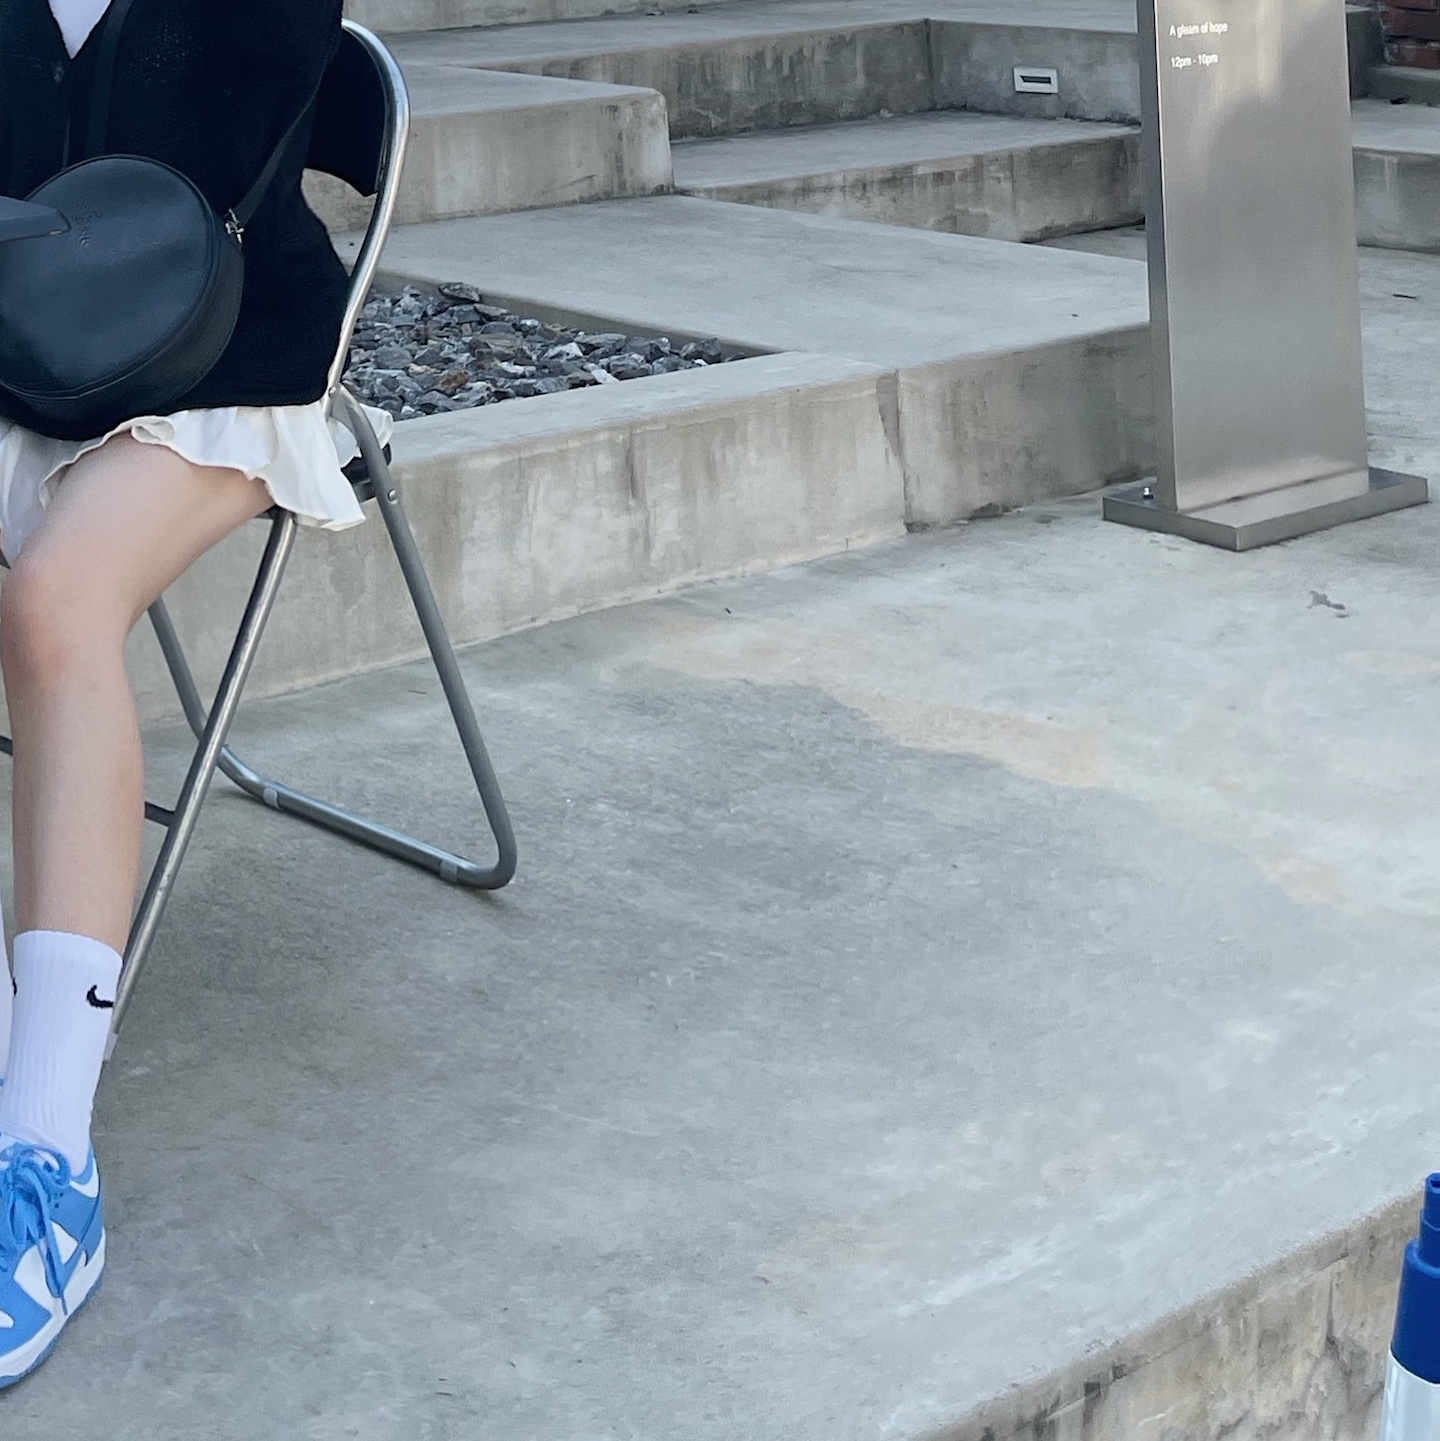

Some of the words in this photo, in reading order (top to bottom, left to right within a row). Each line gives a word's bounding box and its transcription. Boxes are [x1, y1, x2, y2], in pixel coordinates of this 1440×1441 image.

[1169, 24, 1176, 36] A
[1177, 24, 1200, 38] gleam
[1200, 21, 1209, 34] of
[1209, 21, 1228, 35] hope
[1171, 56, 1192, 69] 12pm
[1198, 53, 1219, 67] 10pm
